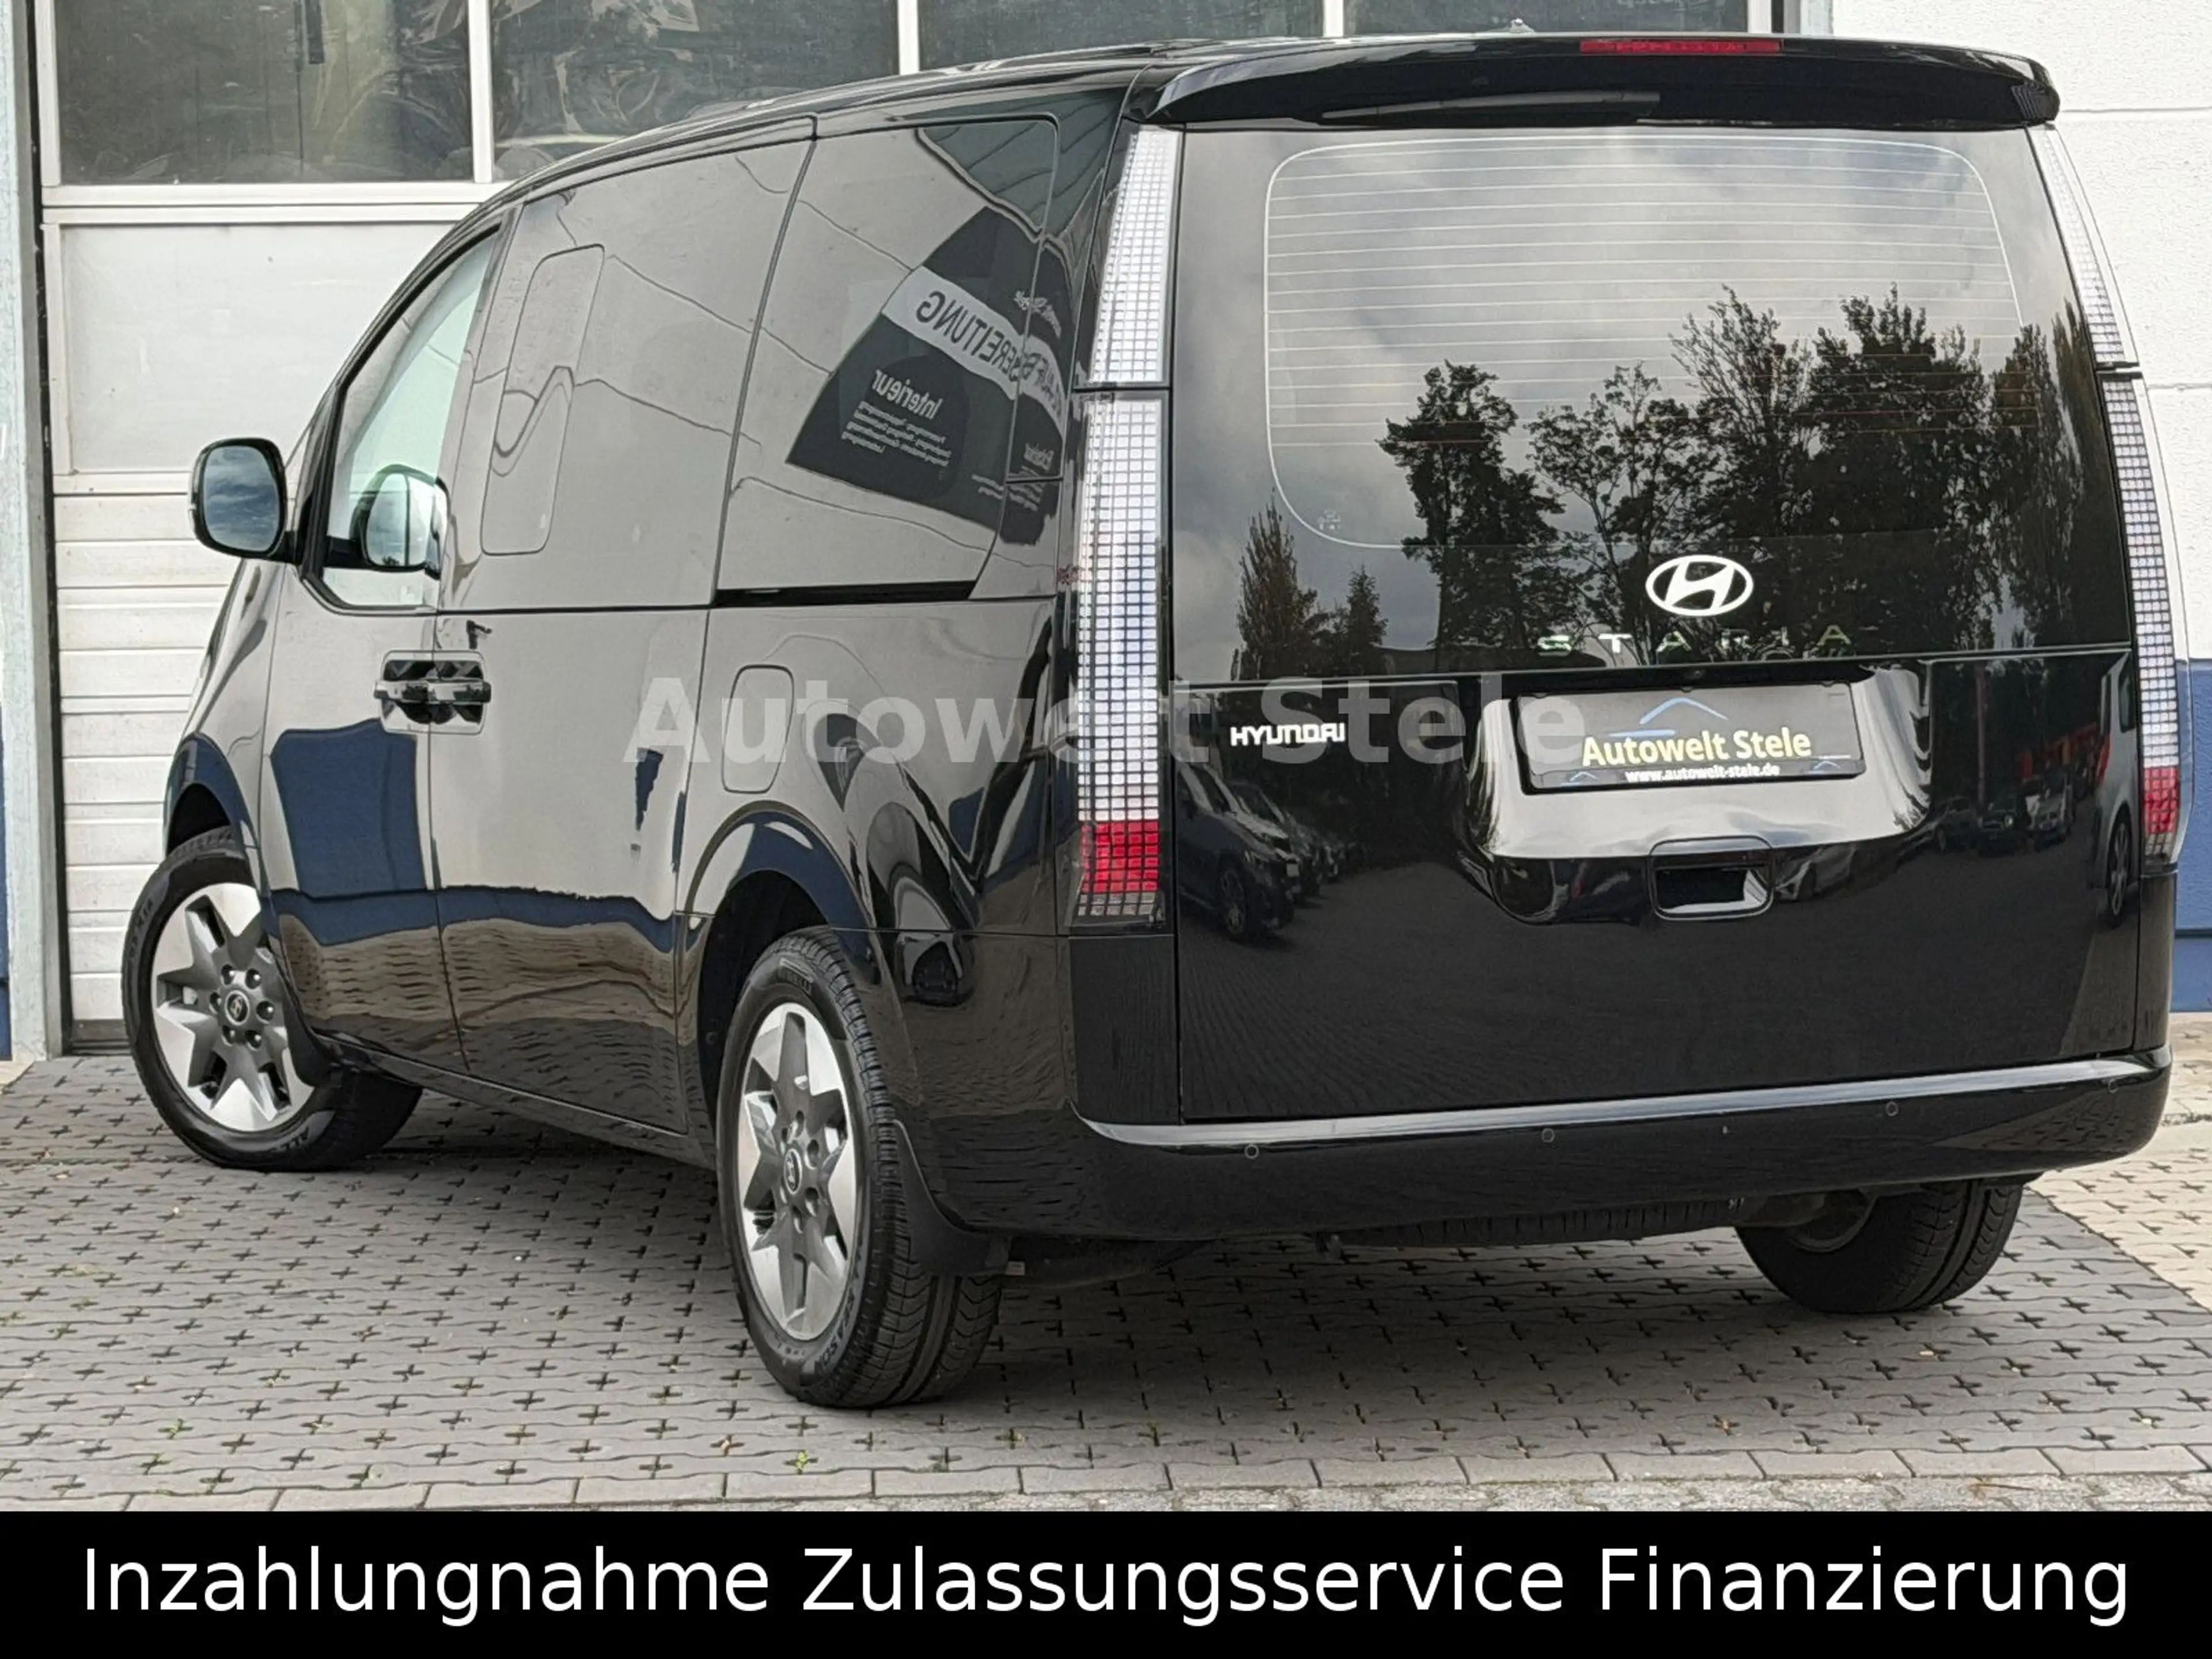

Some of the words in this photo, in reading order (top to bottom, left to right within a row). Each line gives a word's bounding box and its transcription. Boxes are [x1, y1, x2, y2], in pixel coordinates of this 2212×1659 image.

[1230, 722, 1346, 747] HYUNDAI
[1582, 730, 1729, 767] Autowelt
[1733, 727, 1811, 759] Stele
[1624, 763, 1781, 783] www.autowelt-stele.de
